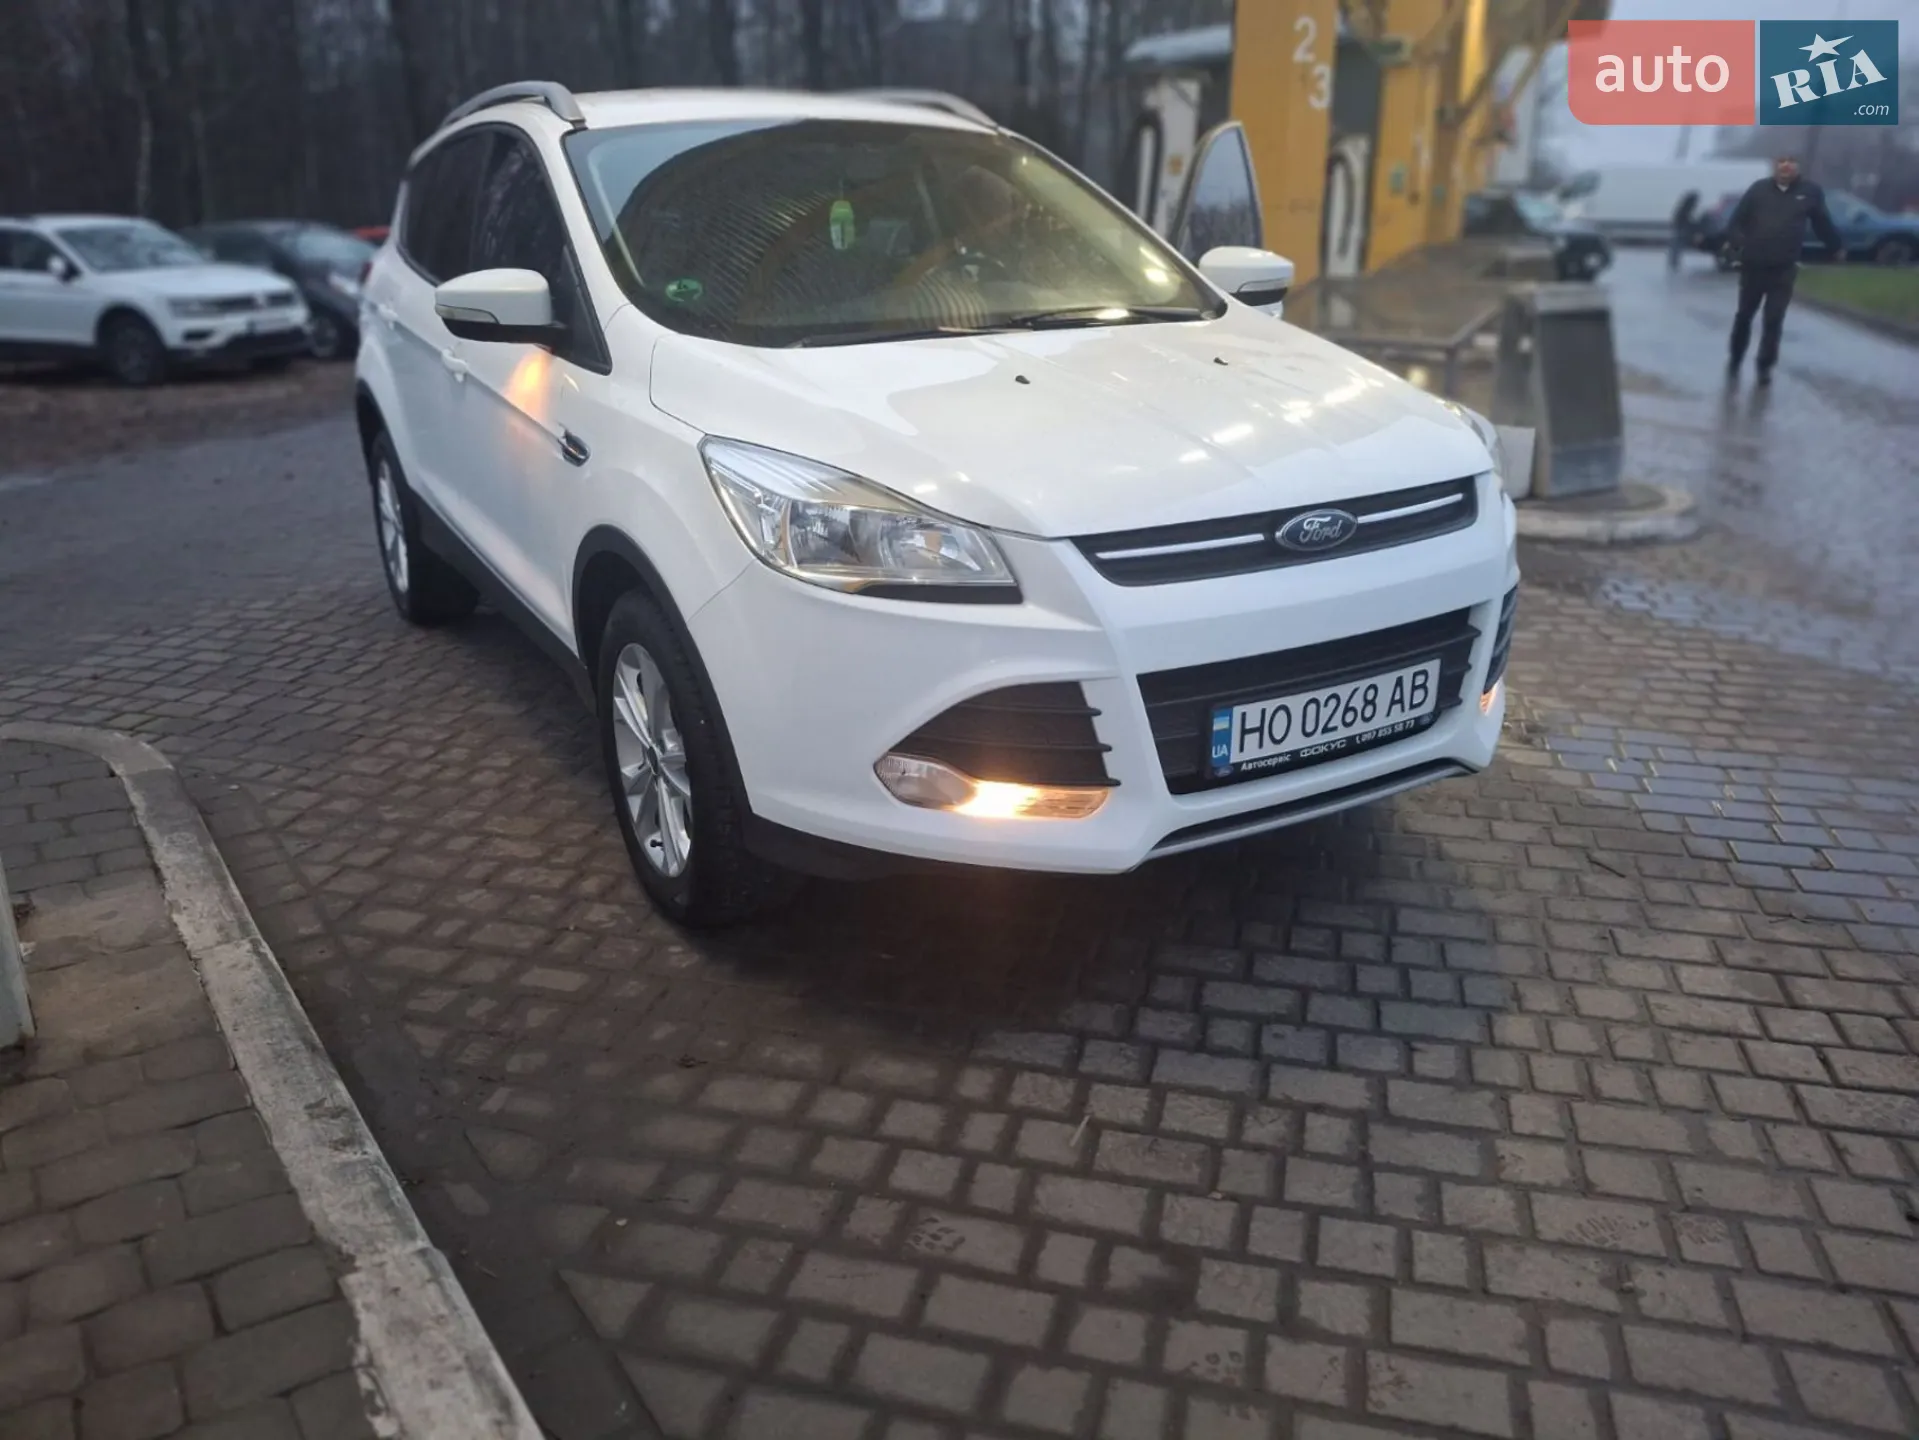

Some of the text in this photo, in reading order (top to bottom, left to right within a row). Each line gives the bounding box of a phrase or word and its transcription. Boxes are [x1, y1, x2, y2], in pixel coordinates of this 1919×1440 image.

[1293, 15, 1317, 62] 2
[1308, 64, 1331, 108] 3
[1299, 516, 1343, 543] Ford
[1239, 669, 1429, 753] HO 0268 AB
[1212, 743, 1228, 758] UA
